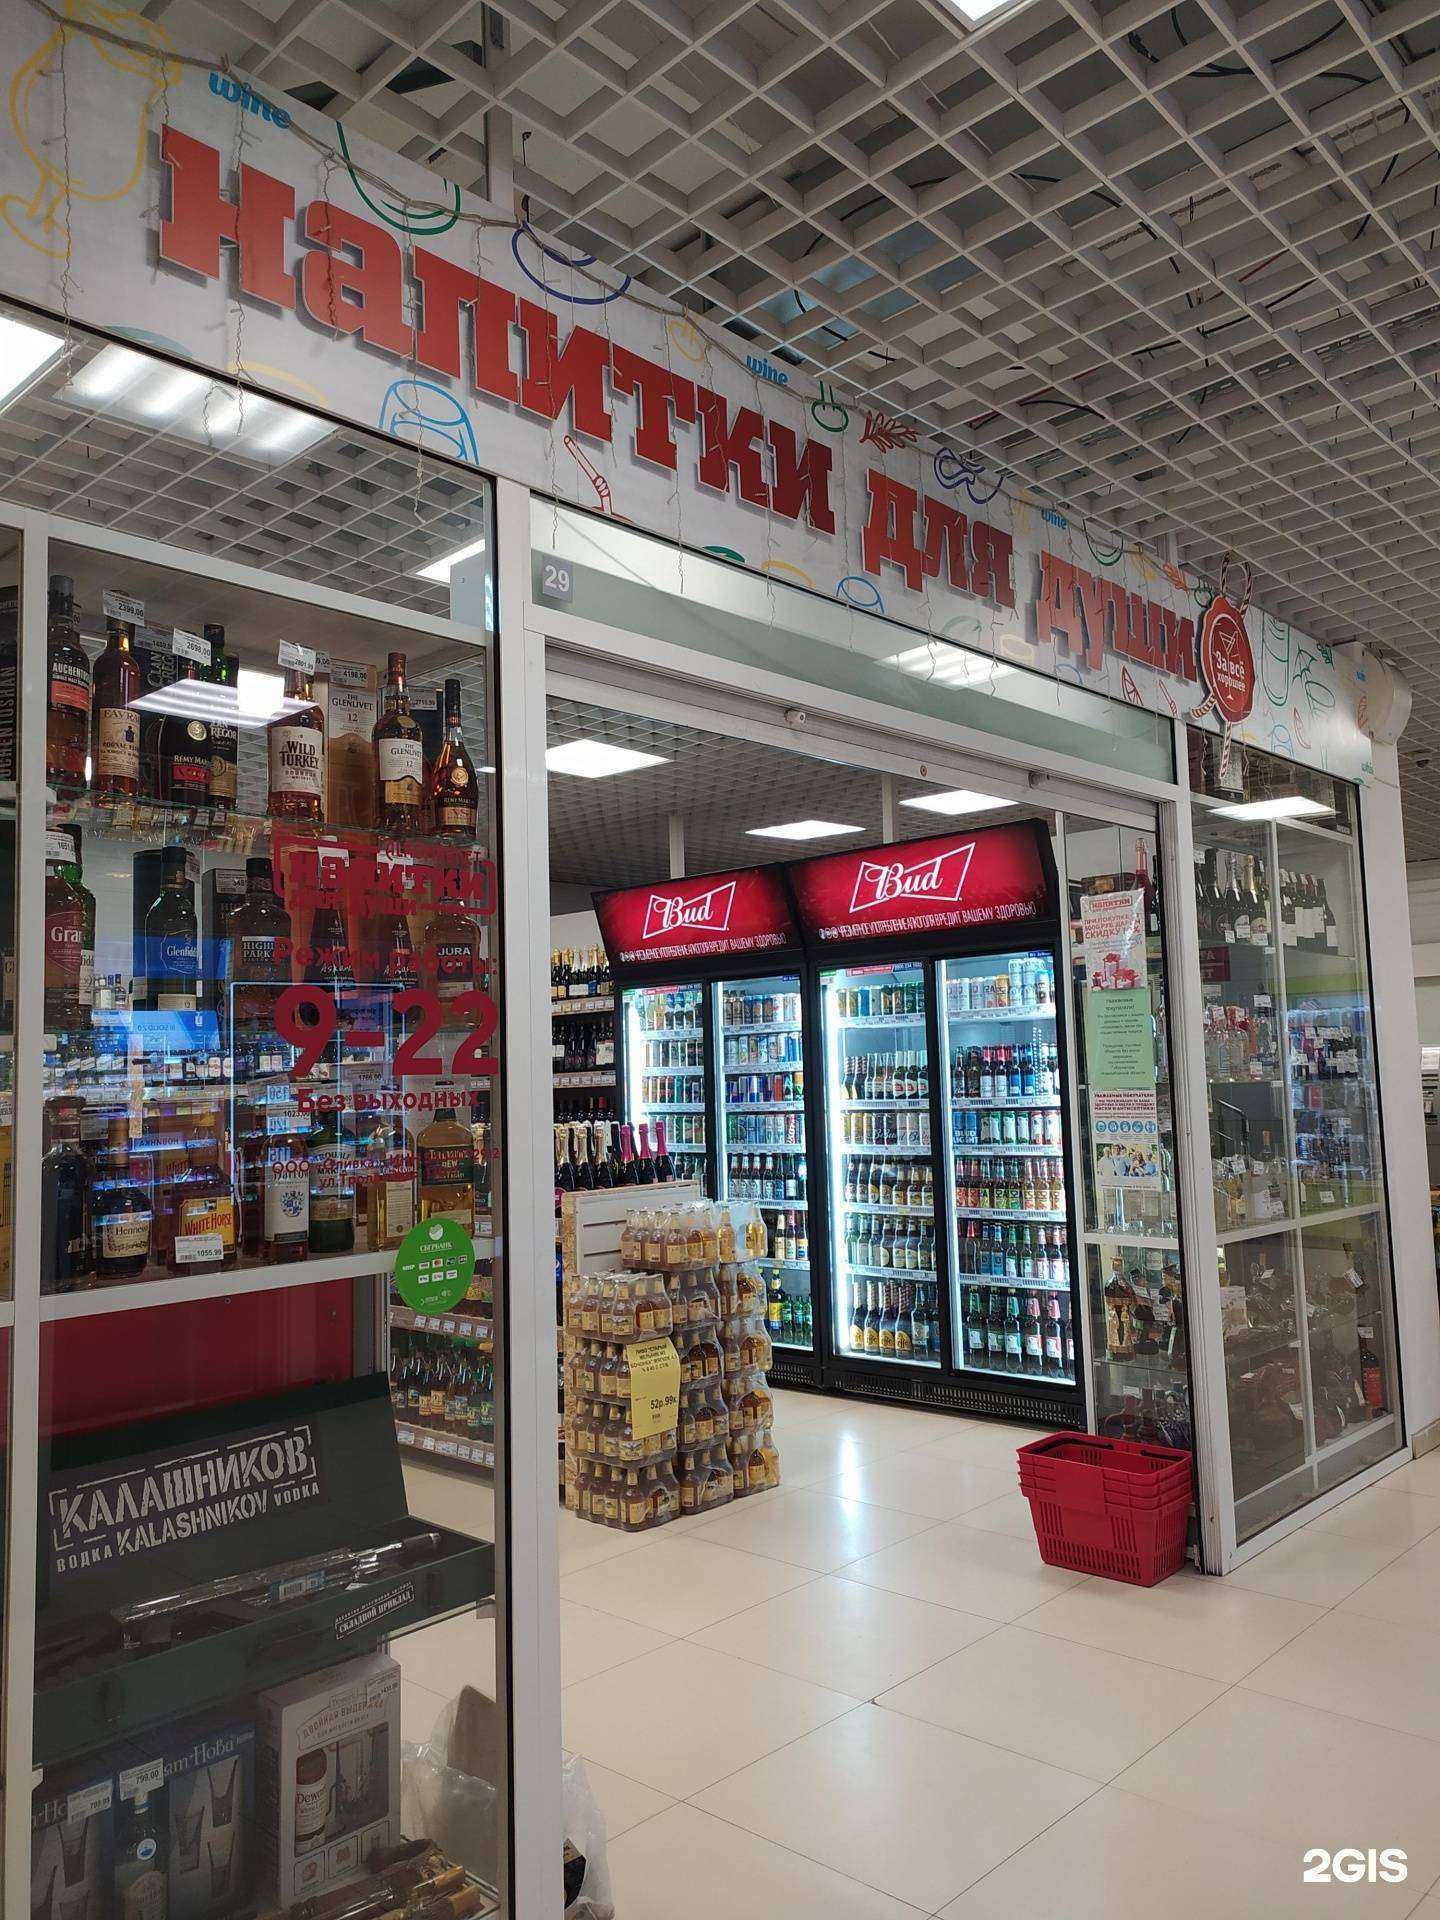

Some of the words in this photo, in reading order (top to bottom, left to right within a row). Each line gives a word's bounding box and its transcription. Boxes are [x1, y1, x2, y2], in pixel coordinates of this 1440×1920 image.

[208, 71, 290, 129] wine
[746, 355, 789, 385] wine
[544, 564, 570, 592] 29
[861, 468, 1015, 608] для
[1038, 550, 1198, 683] души
[1215, 652, 1228, 670] За
[1229, 659, 1245, 678] всё
[331, 697, 374, 711] GLENLIVET
[348, 713, 359, 723] 12
[279, 750, 320, 769] TURKEY
[286, 740, 316, 756] WILD
[864, 858, 944, 900] Bud
[653, 895, 714, 929] Bud
[962, 906, 994, 923] ВАШЕМУ
[995, 900, 1037, 921] ЗДОРОВЬЮ
[243, 950, 271, 960] PARK
[437, 944, 474, 957] JURA
[274, 984, 499, 1078] 9-22
[297, 1087, 347, 1113] Без
[352, 1088, 480, 1112] выходных
[185, 1217, 211, 1236] WHITE
[211, 1212, 232, 1230] HORSE
[59, 1436, 309, 1539] КАЛАШНИКОВ
[117, 1489, 268, 1556] KALASHNIKOV
[273, 1482, 321, 1507] VODKA
[56, 1544, 113, 1573] ВОДКА
